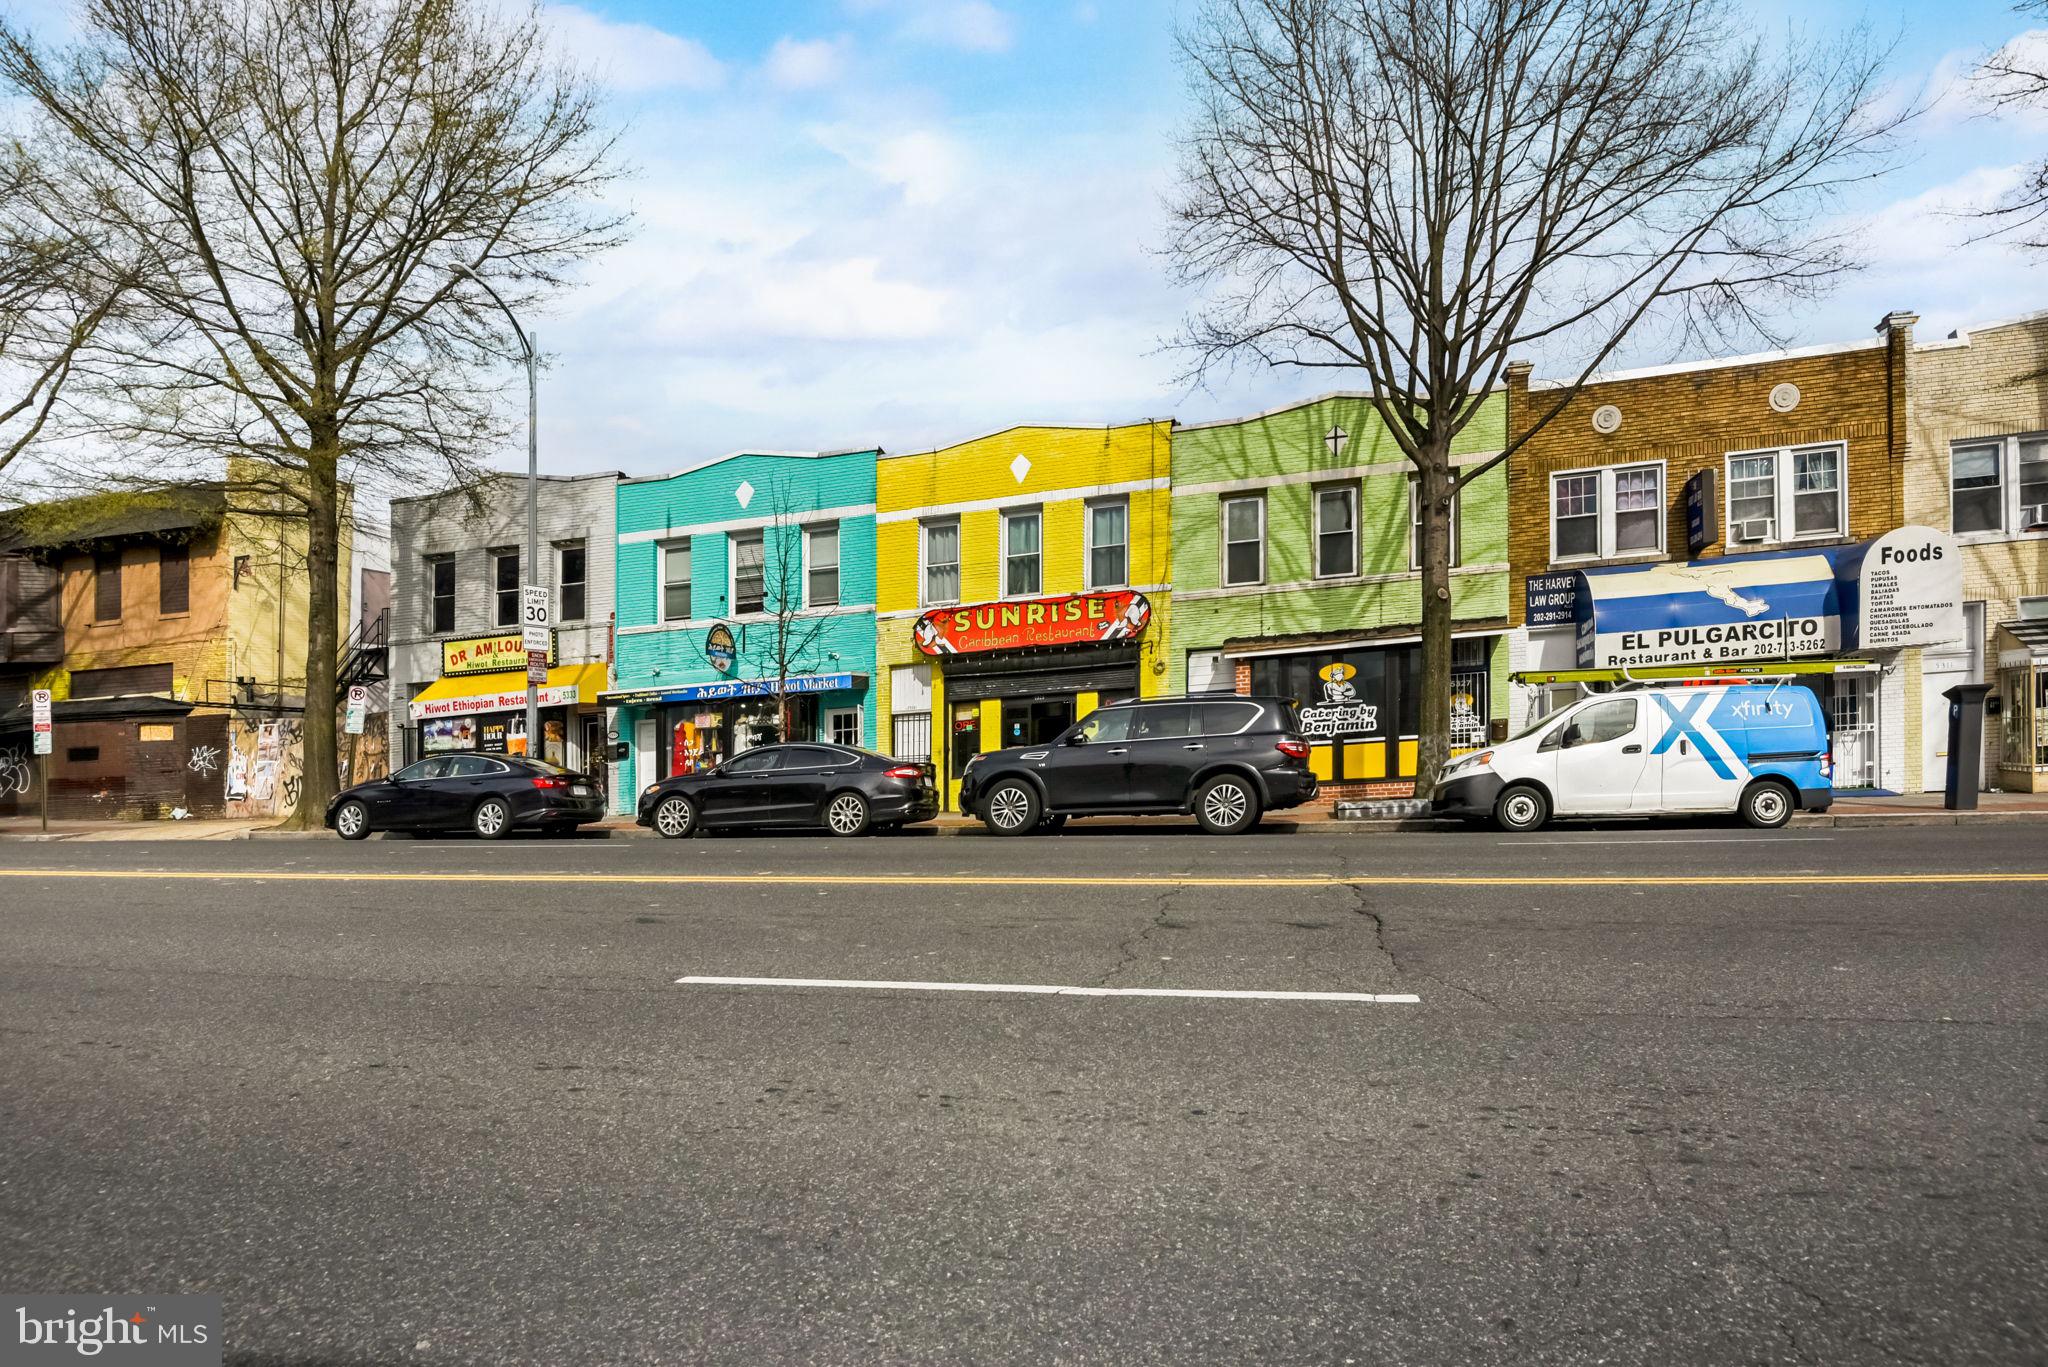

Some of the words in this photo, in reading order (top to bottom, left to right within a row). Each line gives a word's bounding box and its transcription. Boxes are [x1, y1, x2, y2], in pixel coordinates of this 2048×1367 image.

[1881, 542, 1943, 565] Foods
[1528, 579, 1544, 591] THE
[1545, 576, 1577, 590] HARVEY
[525, 588, 548, 598] SPEED
[1529, 595, 1547, 607] LAW
[1548, 592, 1576, 606] GROUP
[527, 598, 545, 606] LIMIT
[1909, 602, 1953, 610] ENTOMATADOS
[526, 606, 547, 622] 30
[954, 599, 1106, 632] SUNRISE
[1533, 611, 1572, 622] 202-291-2914
[1891, 622, 1933, 630] ENCEBOLLADO
[958, 631, 1019, 650] Caribbean
[1022, 622, 1096, 642] Restaurant
[1622, 632, 1650, 651] EL
[1658, 619, 1819, 648] PULGARCITO
[1608, 650, 1697, 667] Restaurant
[1703, 648, 1713, 659] &
[1719, 646, 1748, 658] Bar
[1754, 638, 1826, 655] 202-73-5262
[466, 661, 488, 669] Hiwot
[492, 656, 528, 667] Restaura
[770, 679, 800, 693] Hwot
[802, 677, 840, 690] Market
[424, 703, 450, 715] Hiwot
[452, 699, 495, 712] Ethiopian
[498, 691, 549, 707] Restauant
[1731, 700, 1794, 720] xfinity
[1302, 706, 1358, 720] Catering
[1360, 705, 1376, 718] by
[483, 725, 505, 733] HAPPY
[1303, 718, 1376, 736] Benjamin
[483, 732, 503, 741] HOUR
